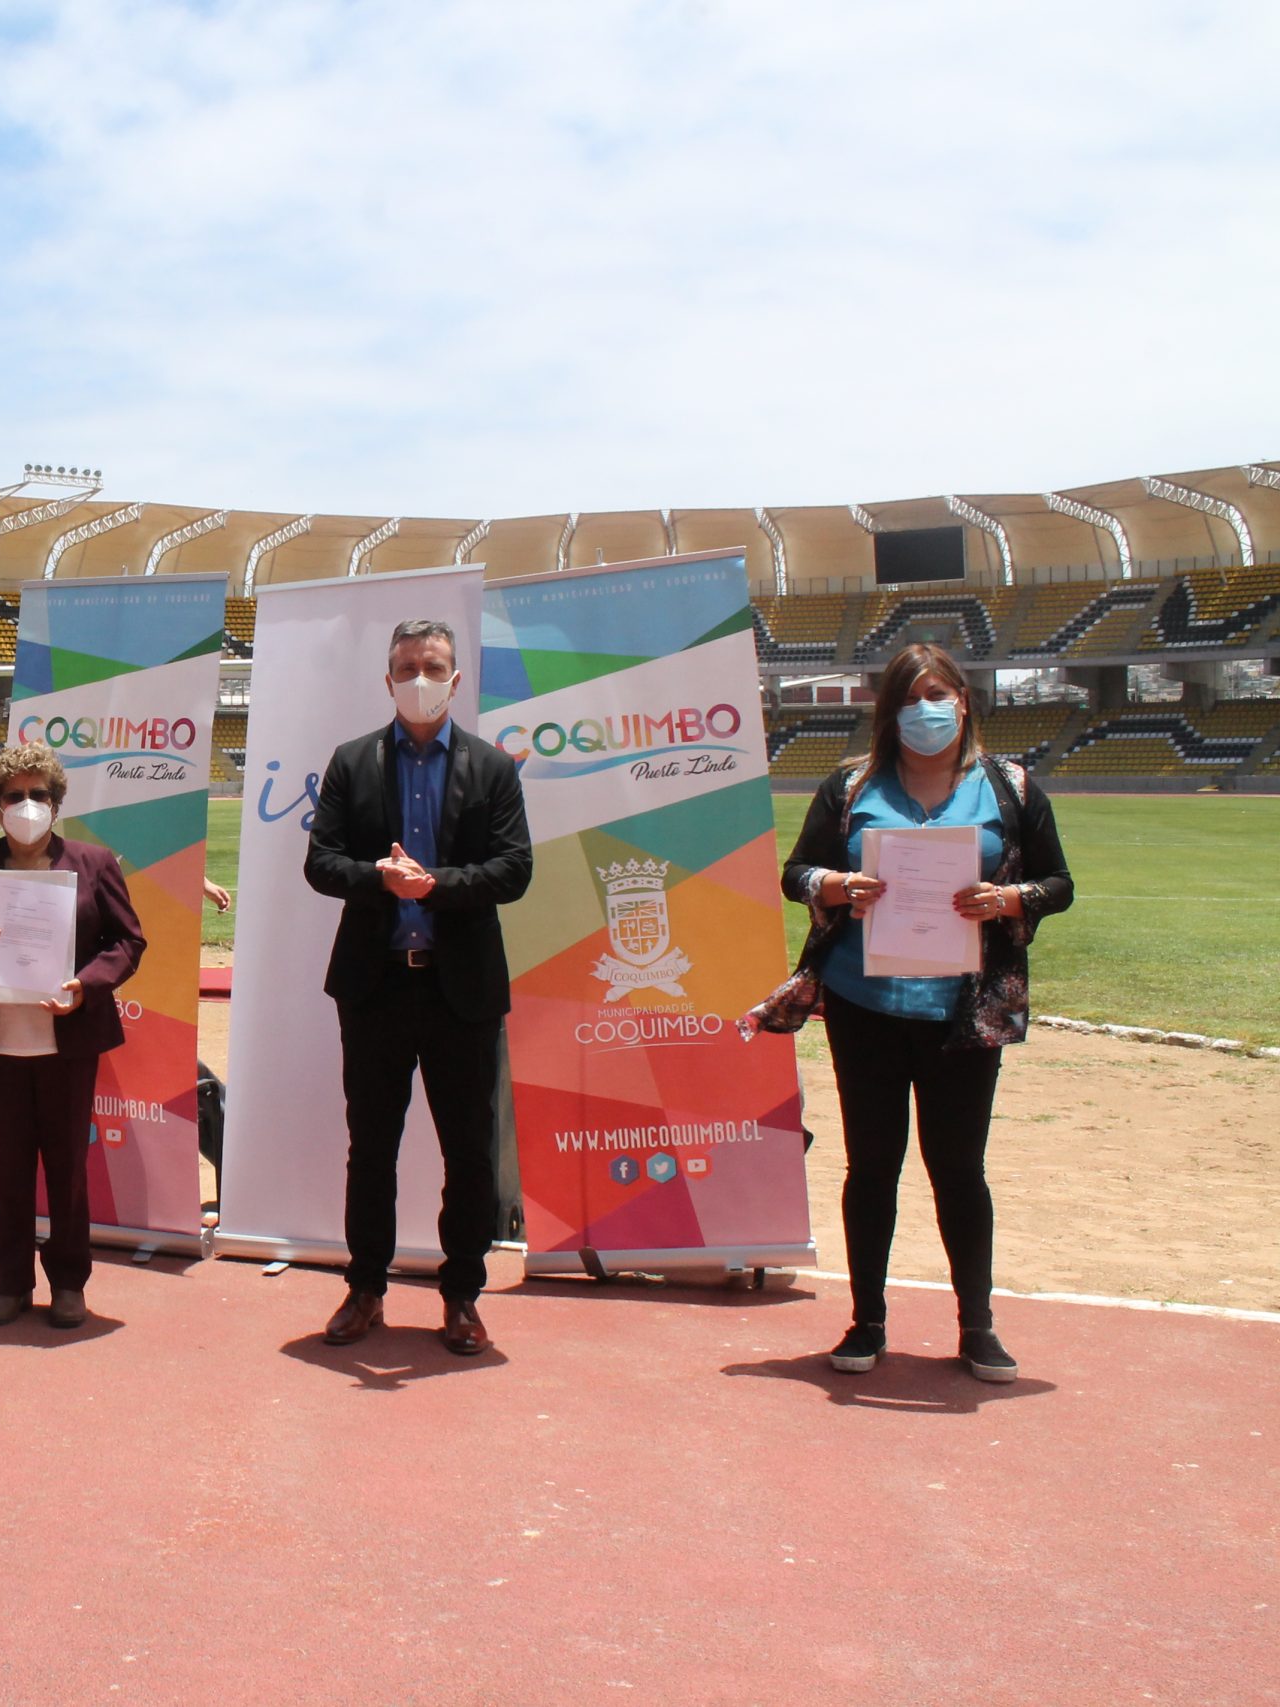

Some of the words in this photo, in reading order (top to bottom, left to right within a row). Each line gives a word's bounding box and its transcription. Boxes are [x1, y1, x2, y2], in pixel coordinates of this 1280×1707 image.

[18, 715, 196, 750] COQUIMBO
[495, 703, 741, 763] COQUIMBO
[107, 761, 145, 779] Puerto
[146, 762, 186, 780] Lindo
[631, 762, 680, 781] Puerto
[683, 754, 737, 776] Lindo
[614, 967, 675, 983] COQUIMBO
[597, 1003, 680, 1019] MUNICIPALIDAD
[681, 1002, 695, 1012] DE
[575, 1013, 723, 1045] COQUIMBO
[93, 1095, 167, 1124] QUIMBO.CL
[555, 1119, 763, 1153] WWW.MUNICOQUIMBO.CL
